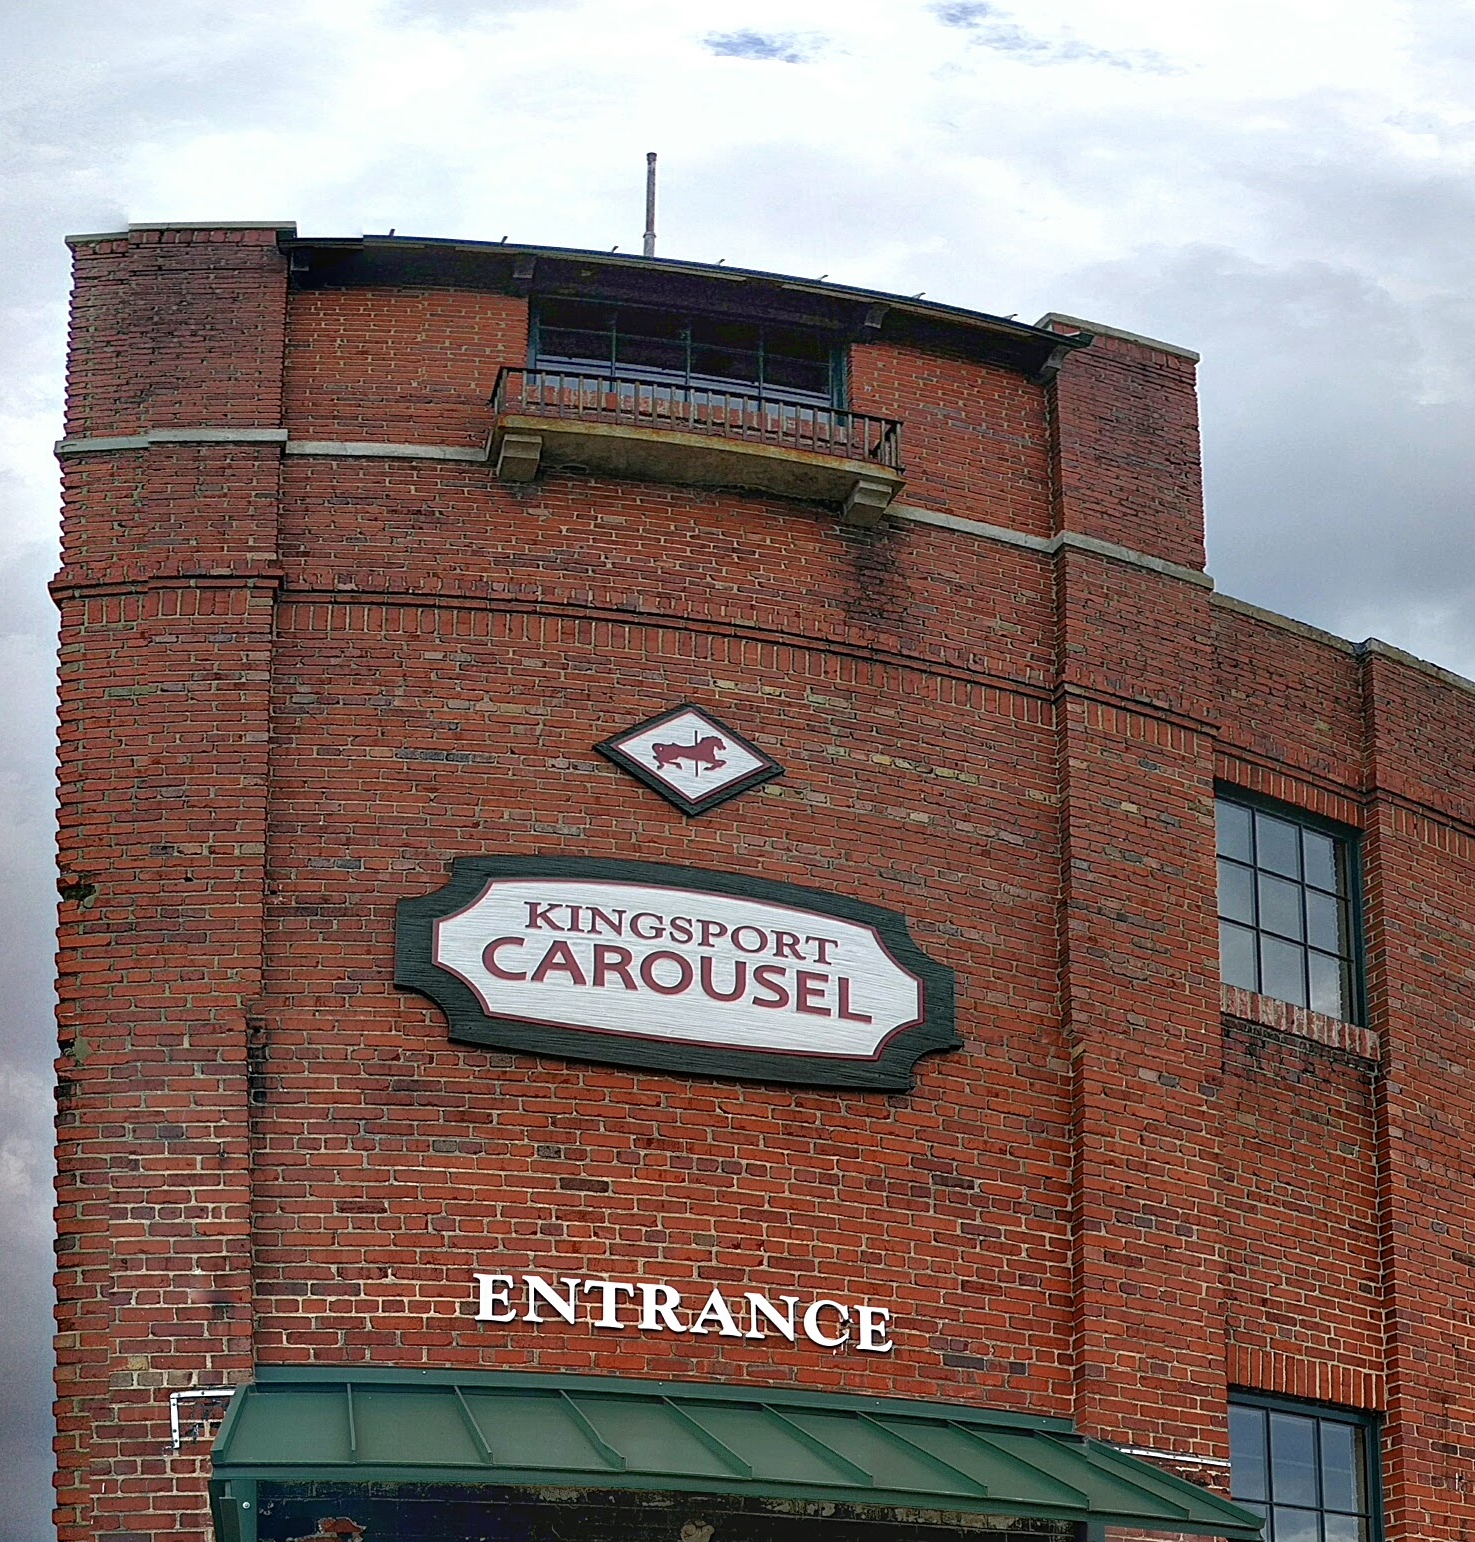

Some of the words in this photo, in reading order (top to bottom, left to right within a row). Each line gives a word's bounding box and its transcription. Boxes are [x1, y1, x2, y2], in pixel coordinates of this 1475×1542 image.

[523, 900, 839, 965] KINGSPORT
[480, 935, 873, 1024] CAROUSEL
[472, 1272, 894, 1353] ENTRANCE
